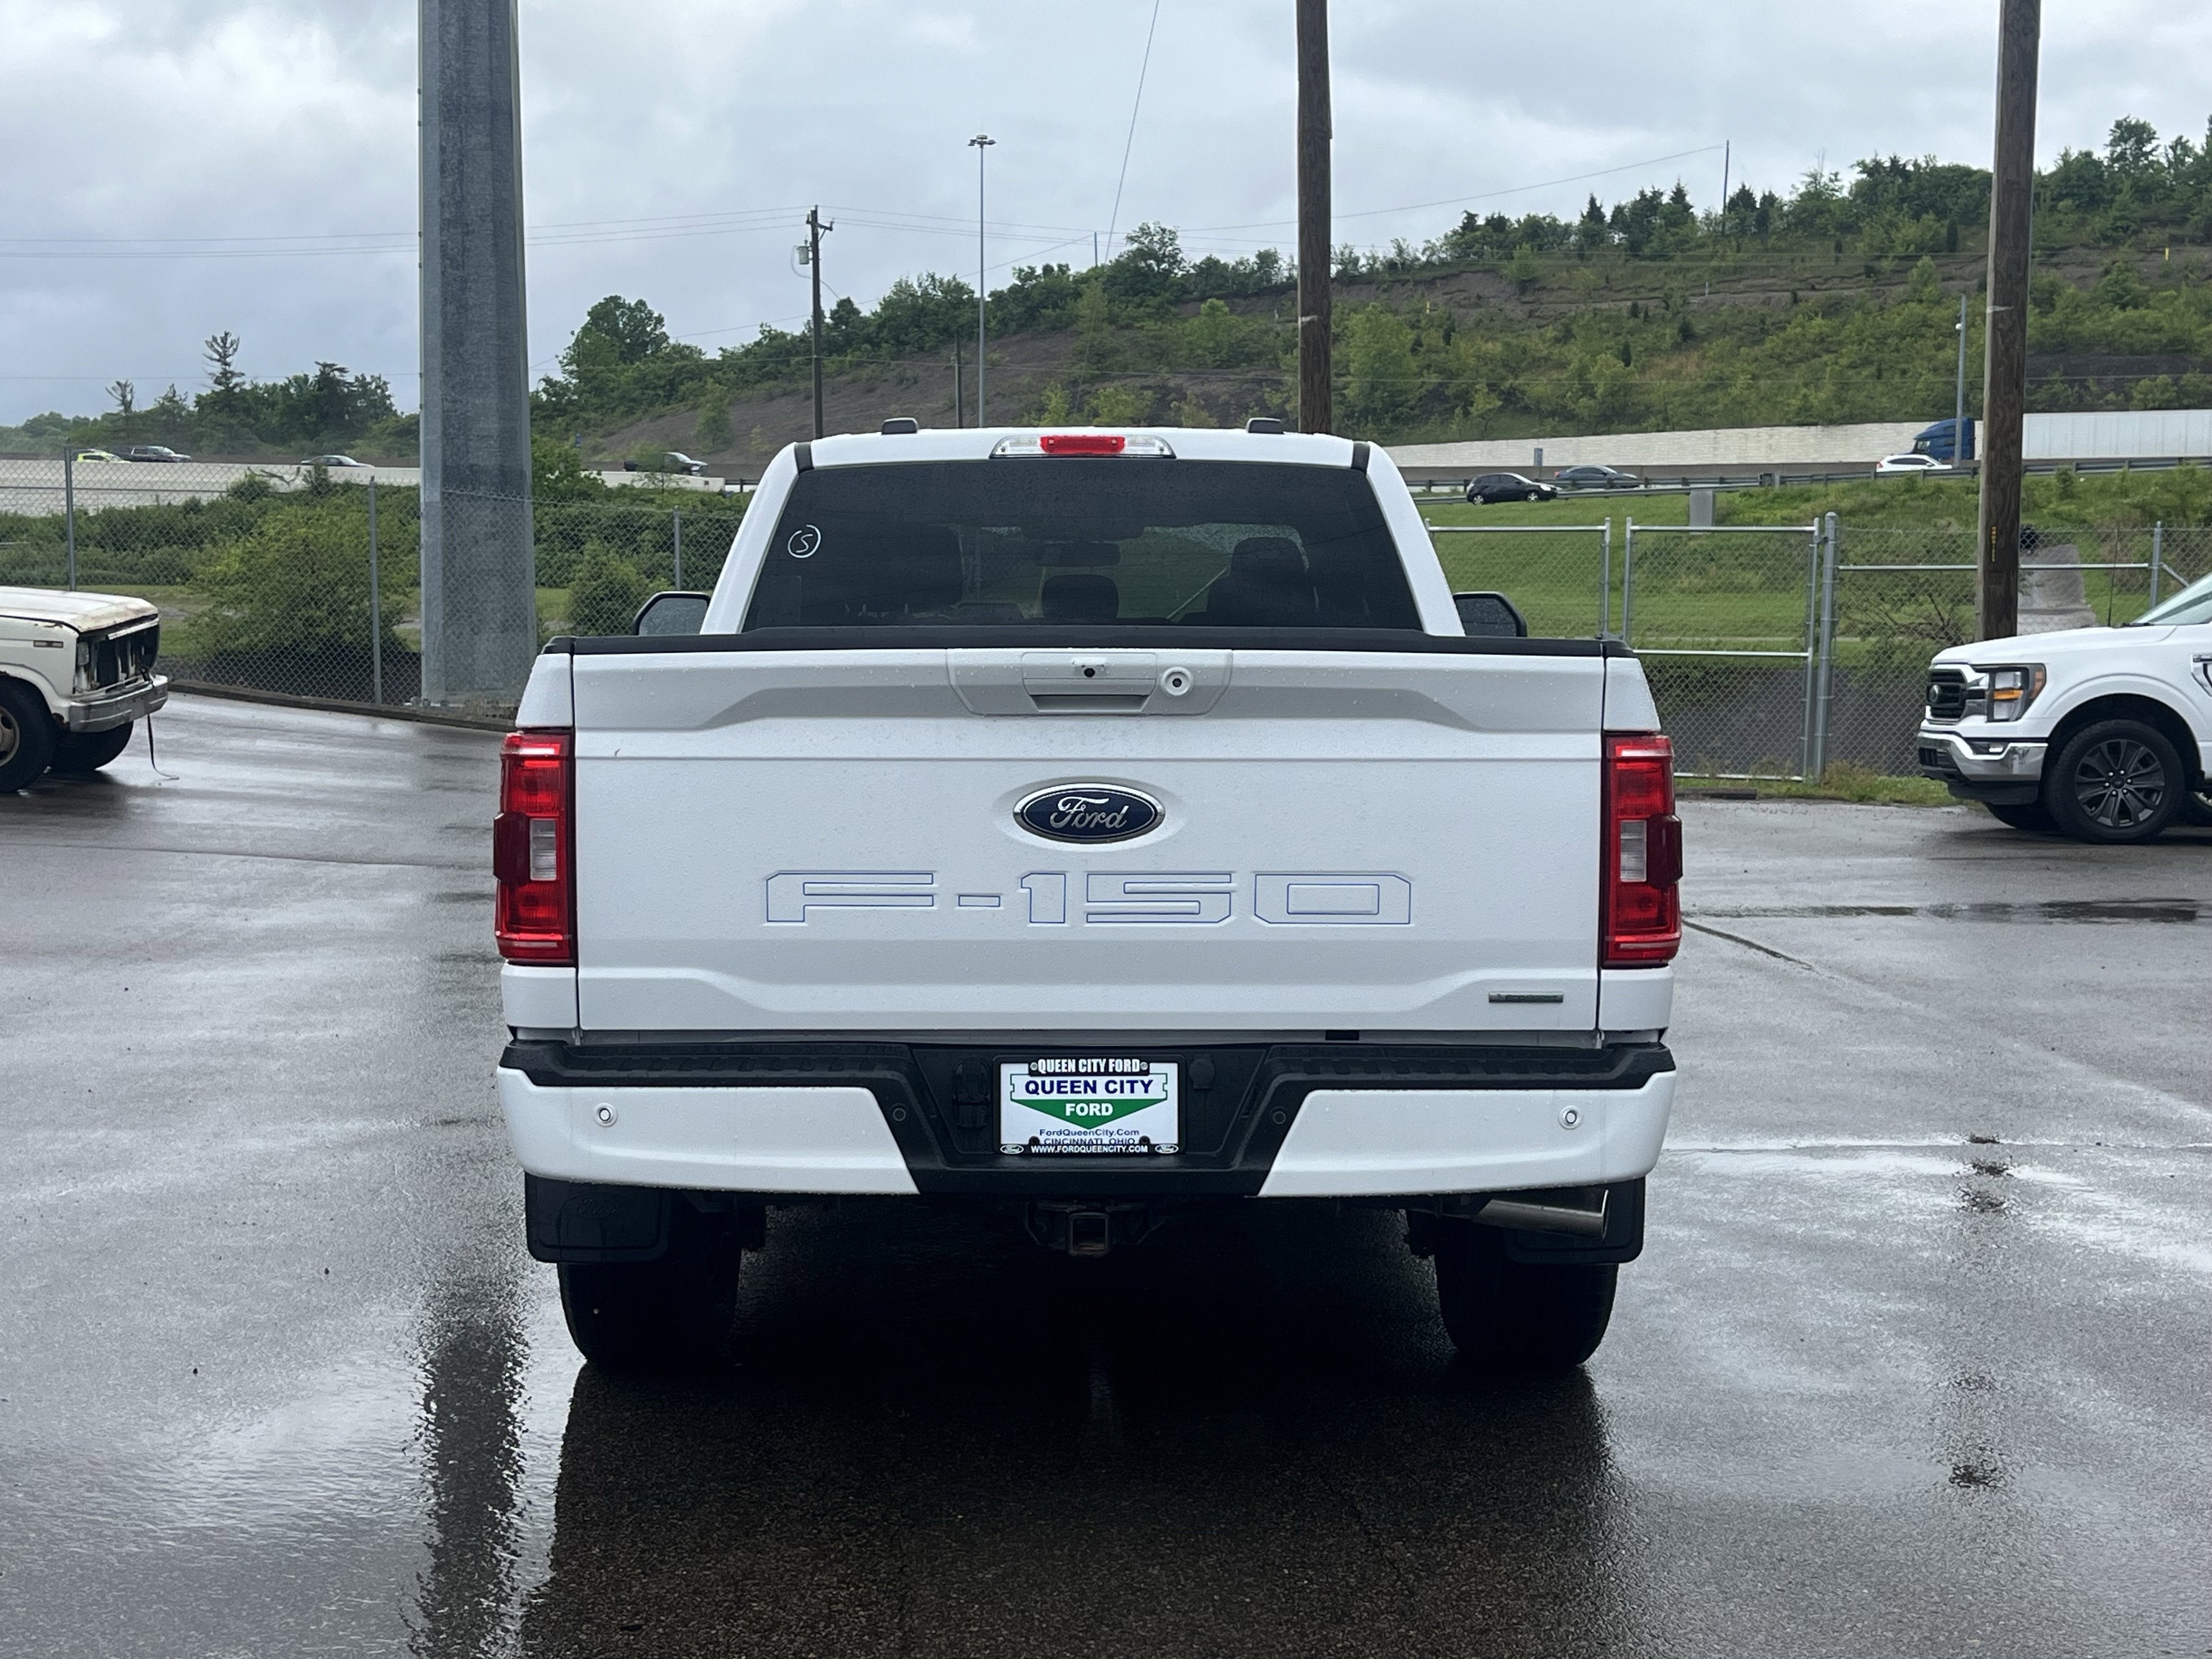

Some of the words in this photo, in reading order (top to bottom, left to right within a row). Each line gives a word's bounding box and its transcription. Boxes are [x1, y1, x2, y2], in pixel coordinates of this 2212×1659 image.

[1049, 796, 1130, 829] Ford
[765, 872, 1410, 924] F-150
[1037, 1059, 1076, 1074] QUEEN
[1078, 1058, 1107, 1073] CITY
[1108, 1058, 1140, 1073] FORD
[1025, 1080, 1097, 1095] QUEEN
[1104, 1080, 1154, 1094] CITY
[1065, 1103, 1113, 1116] FORD
[1040, 1128, 1139, 1137] FordQueenCity.Com
[1031, 1145, 1148, 1153] WWW.FORDQUEENCITY.COM
